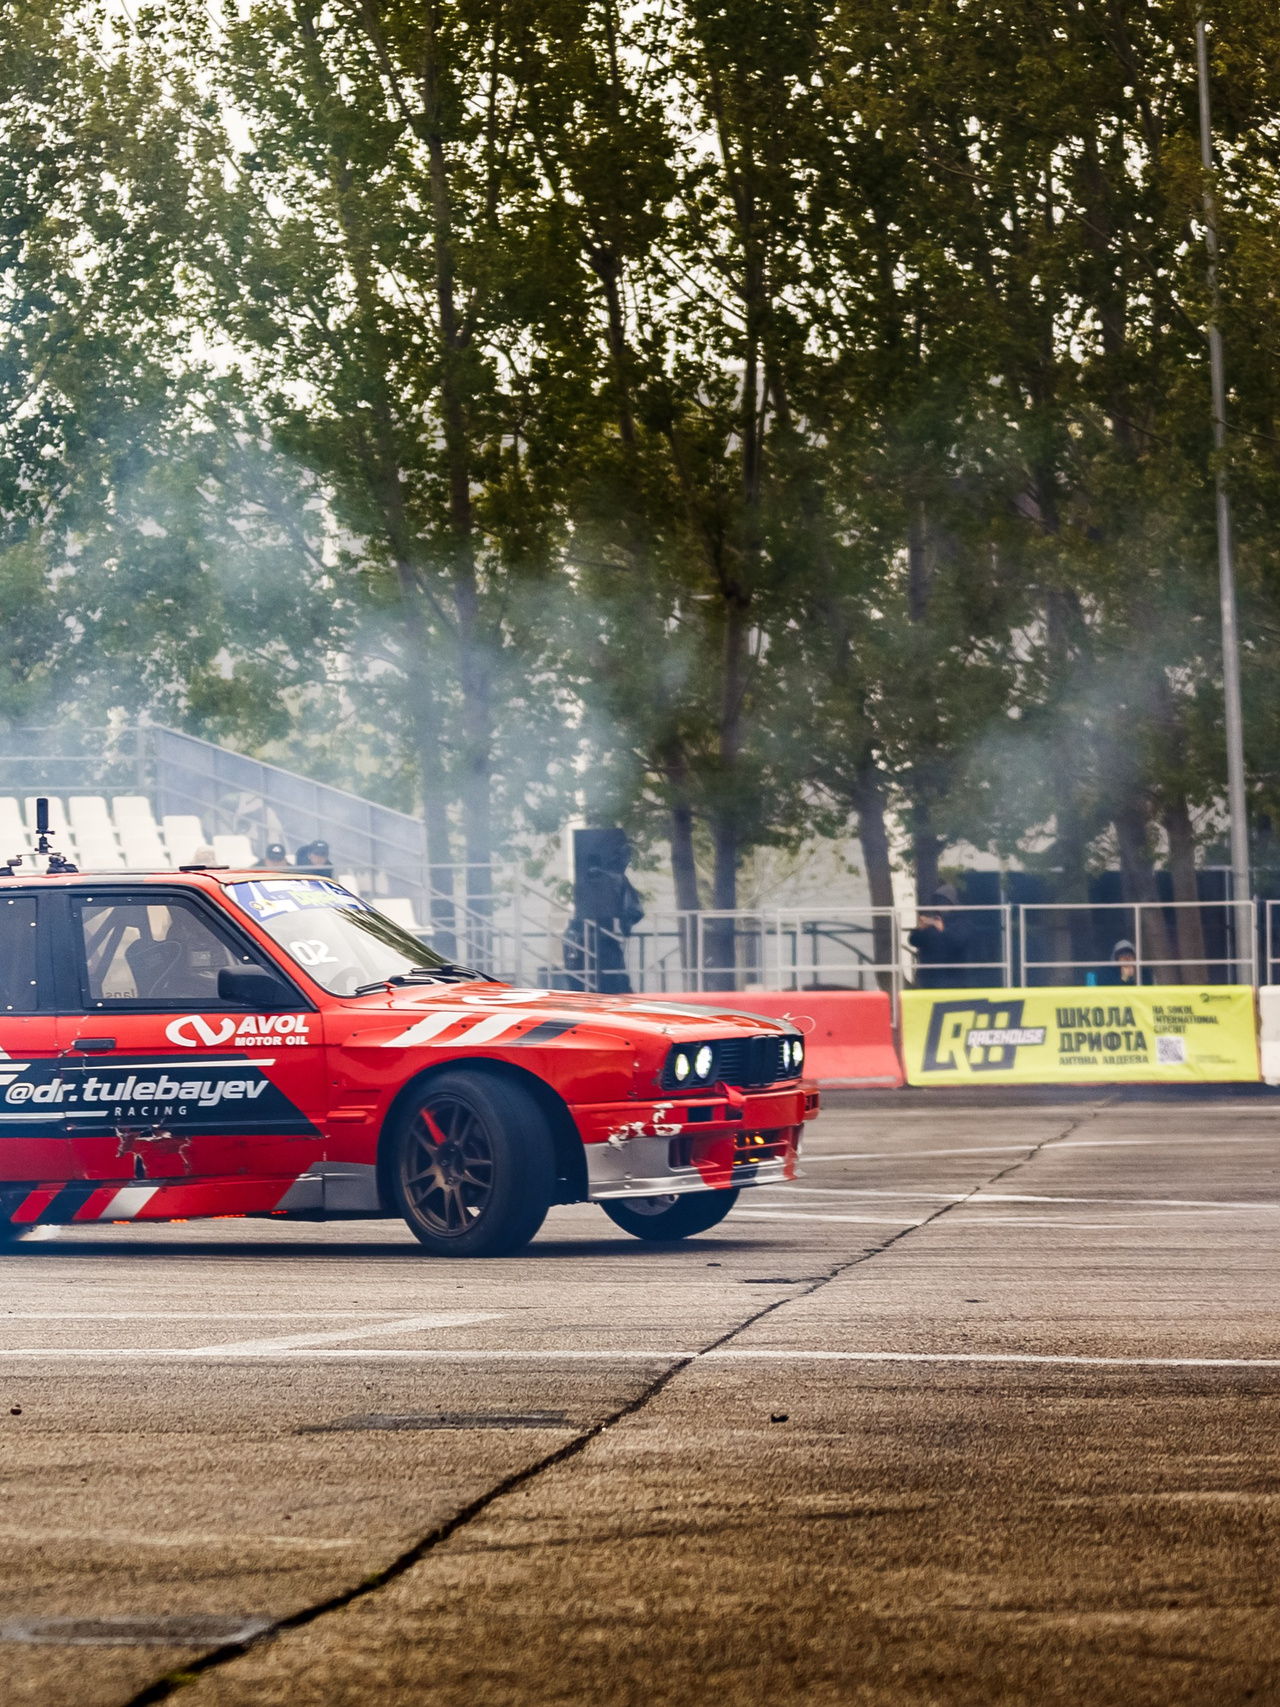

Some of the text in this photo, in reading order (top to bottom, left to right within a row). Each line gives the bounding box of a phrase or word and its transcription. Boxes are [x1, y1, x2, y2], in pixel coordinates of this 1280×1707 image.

[289, 939, 339, 966] 02
[236, 1015, 309, 1034] AVOL
[1055, 1006, 1136, 1028] ШКОЛА
[235, 1036, 308, 1046] MOTOR OIL
[967, 1029, 1045, 1046] RACEHOUSE
[1058, 1031, 1148, 1053] ДРИФТА
[5, 1076, 269, 1106] @dr.tulebayev
[114, 1106, 187, 1116] RACING
